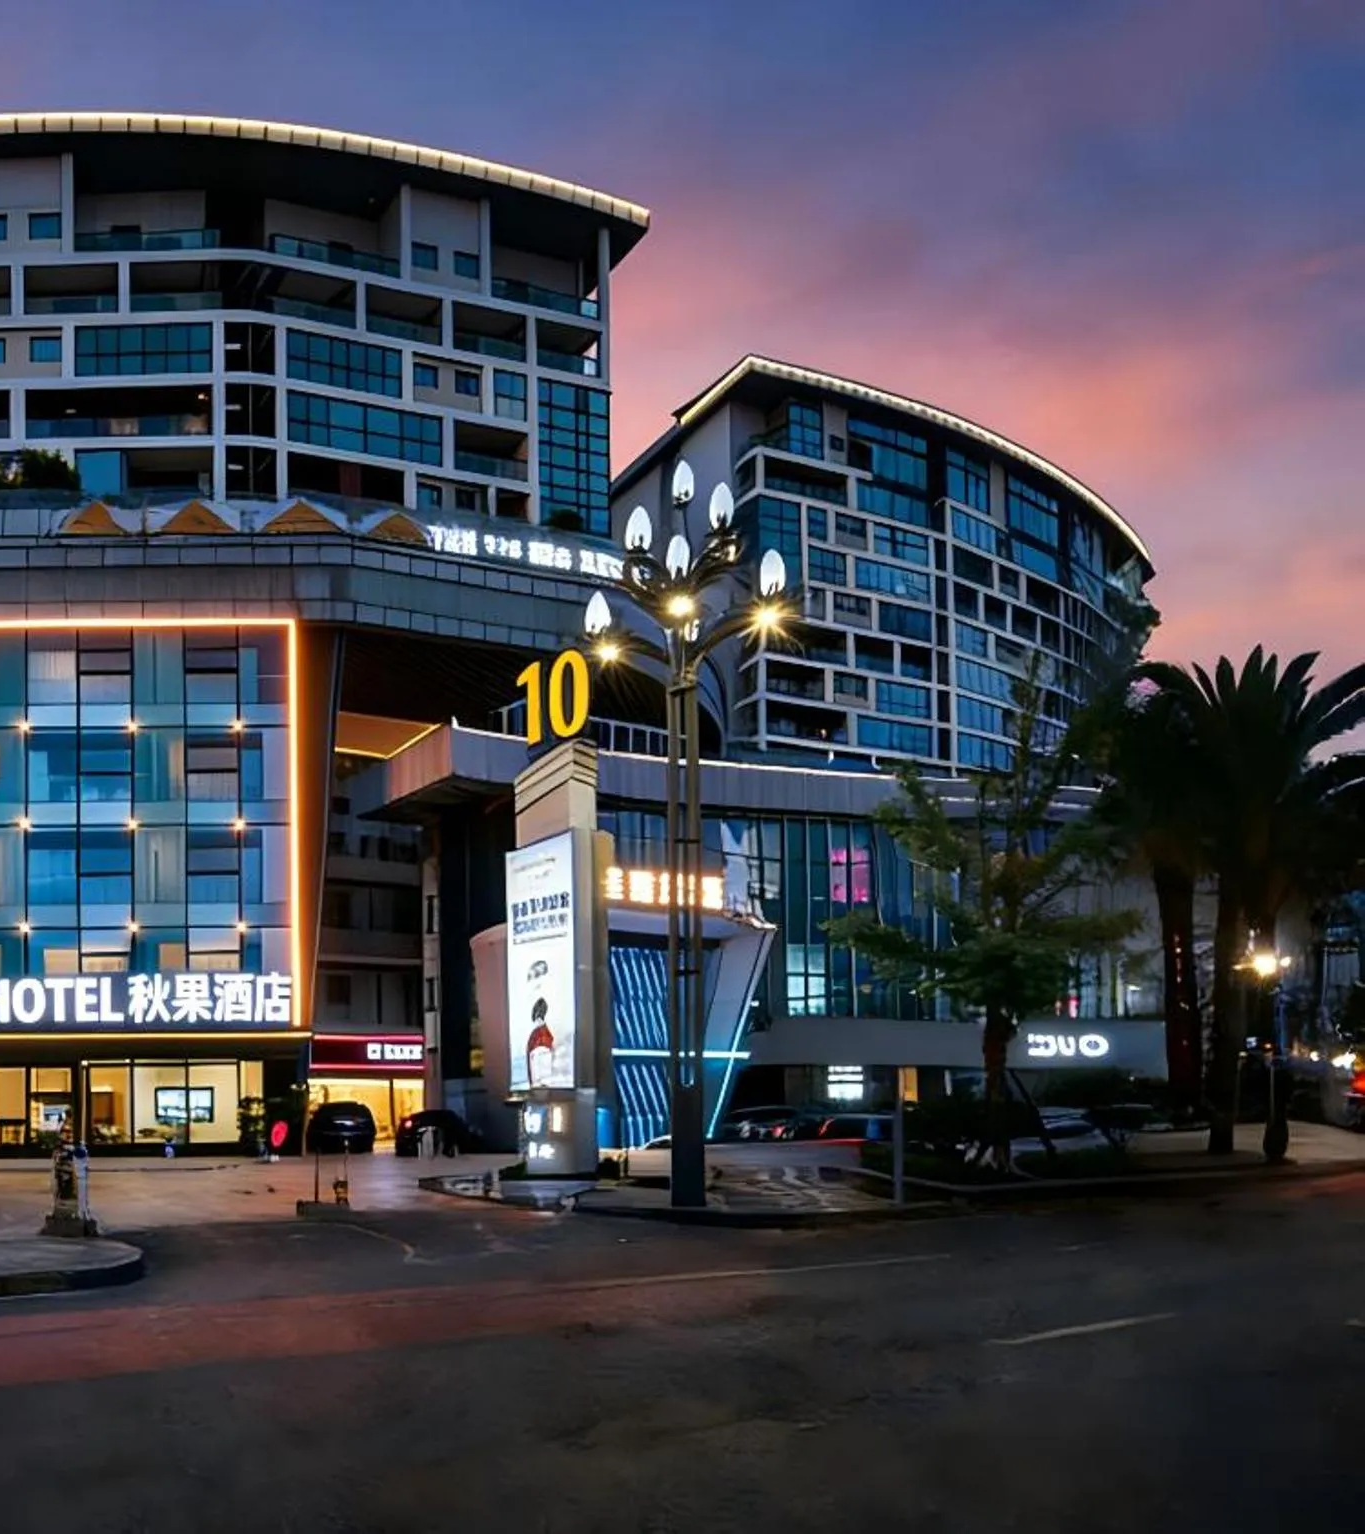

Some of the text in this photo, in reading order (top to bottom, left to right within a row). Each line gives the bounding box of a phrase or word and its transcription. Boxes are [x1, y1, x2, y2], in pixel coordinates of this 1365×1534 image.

[516, 649, 590, 746] 10
[127, 972, 292, 1024] 秋果酒店
